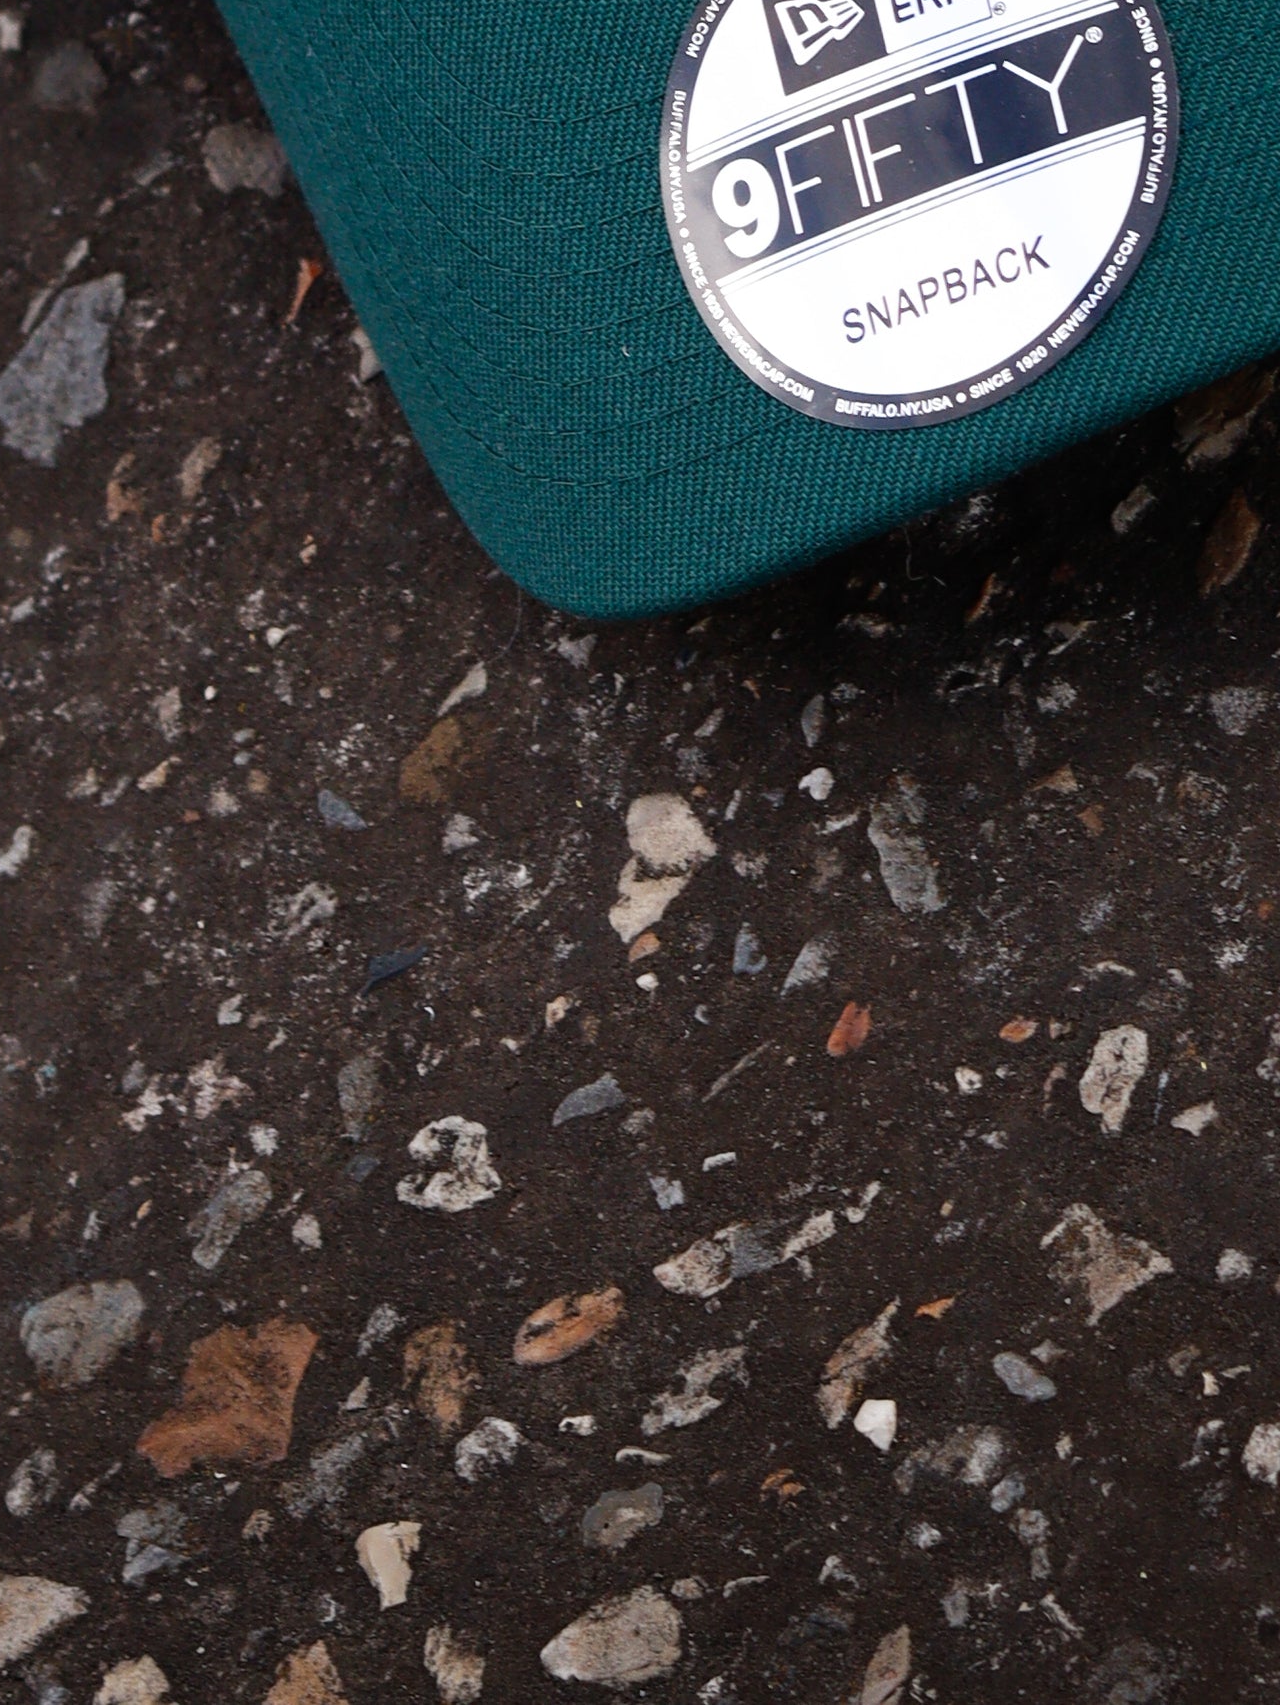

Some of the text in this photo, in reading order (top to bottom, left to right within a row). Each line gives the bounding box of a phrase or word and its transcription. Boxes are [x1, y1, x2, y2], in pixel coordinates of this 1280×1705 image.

[1131, 6, 1159, 53] SINCE
[842, 235, 1051, 354] SNAPBACK
[969, 367, 1014, 399] SINCE
[1015, 345, 1048, 373] 1920
